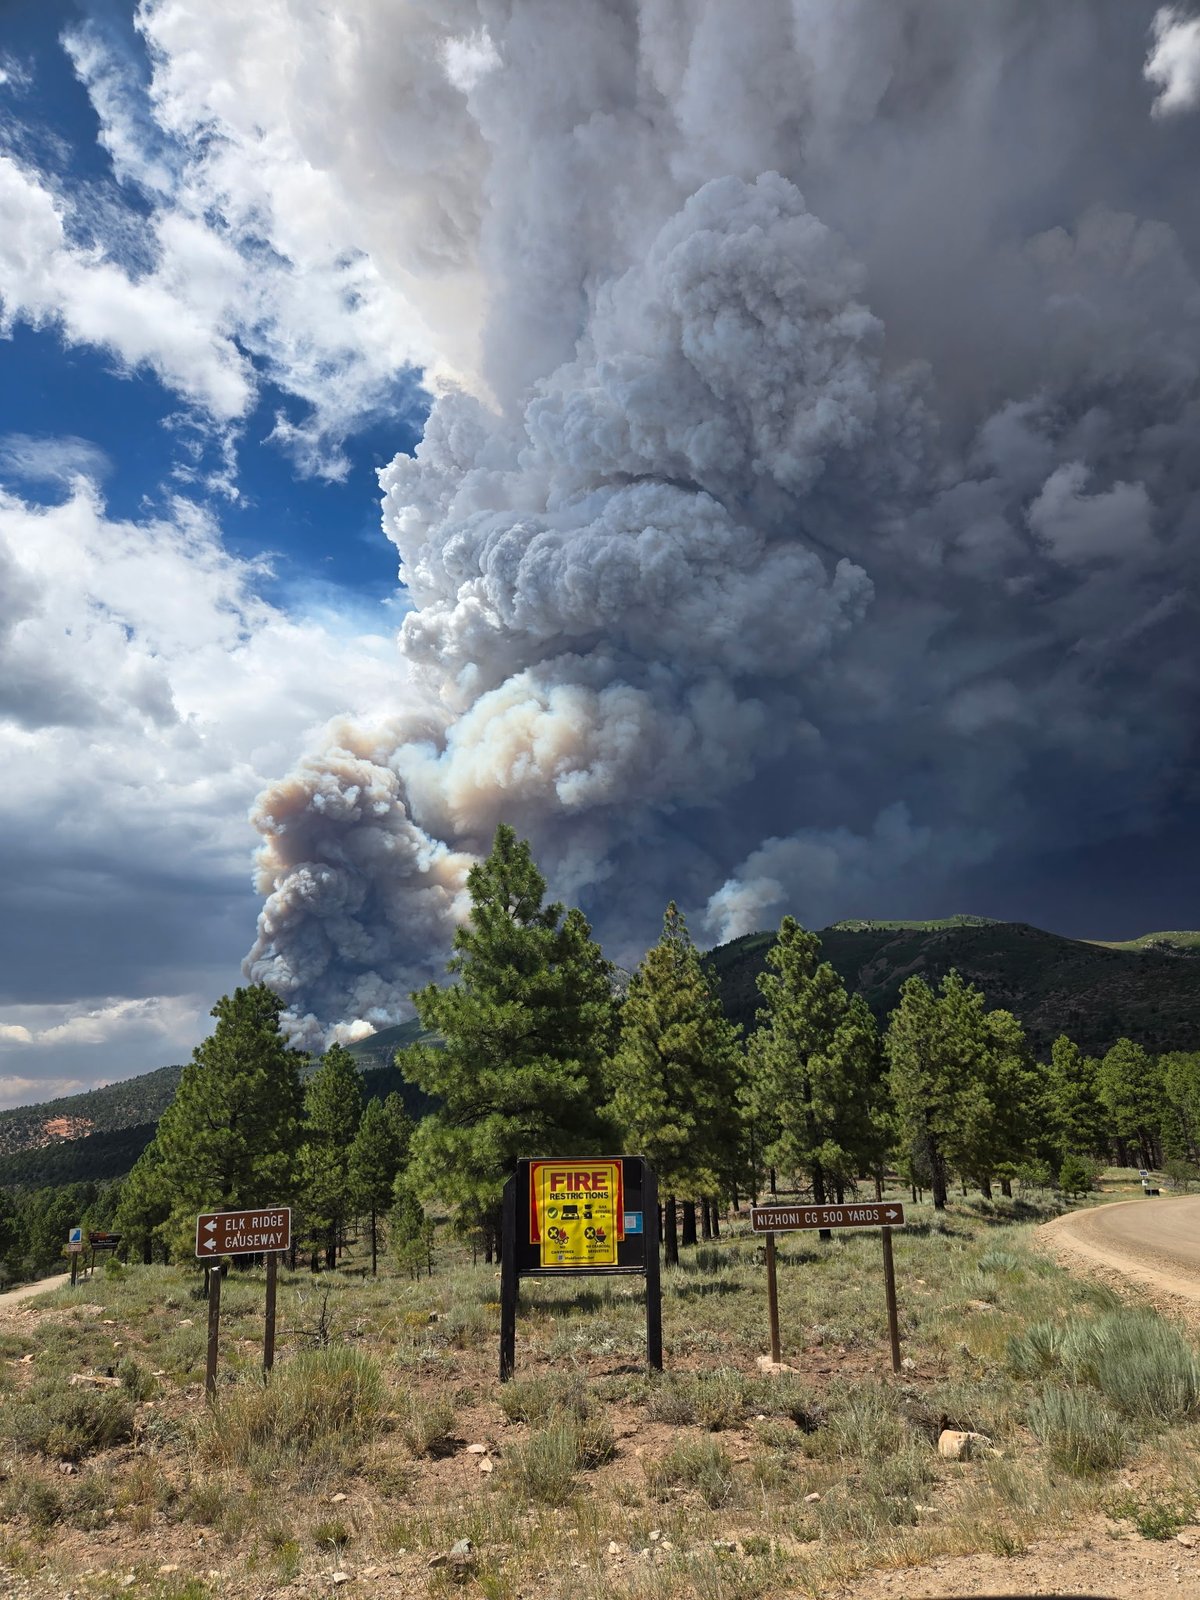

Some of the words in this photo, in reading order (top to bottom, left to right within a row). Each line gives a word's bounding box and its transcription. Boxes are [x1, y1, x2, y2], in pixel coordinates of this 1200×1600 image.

[550, 1171, 609, 1192] FIRE
[549, 1191, 609, 1201] RESTRICTIONS
[225, 1218, 246, 1231] ELK
[252, 1214, 284, 1229] RIDGE
[757, 1212, 800, 1226] NIZHONI
[804, 1211, 818, 1224] CG
[823, 1210, 843, 1223] 500
[847, 1209, 879, 1222] YARDS
[225, 1232, 283, 1248] CAUSEWAY
